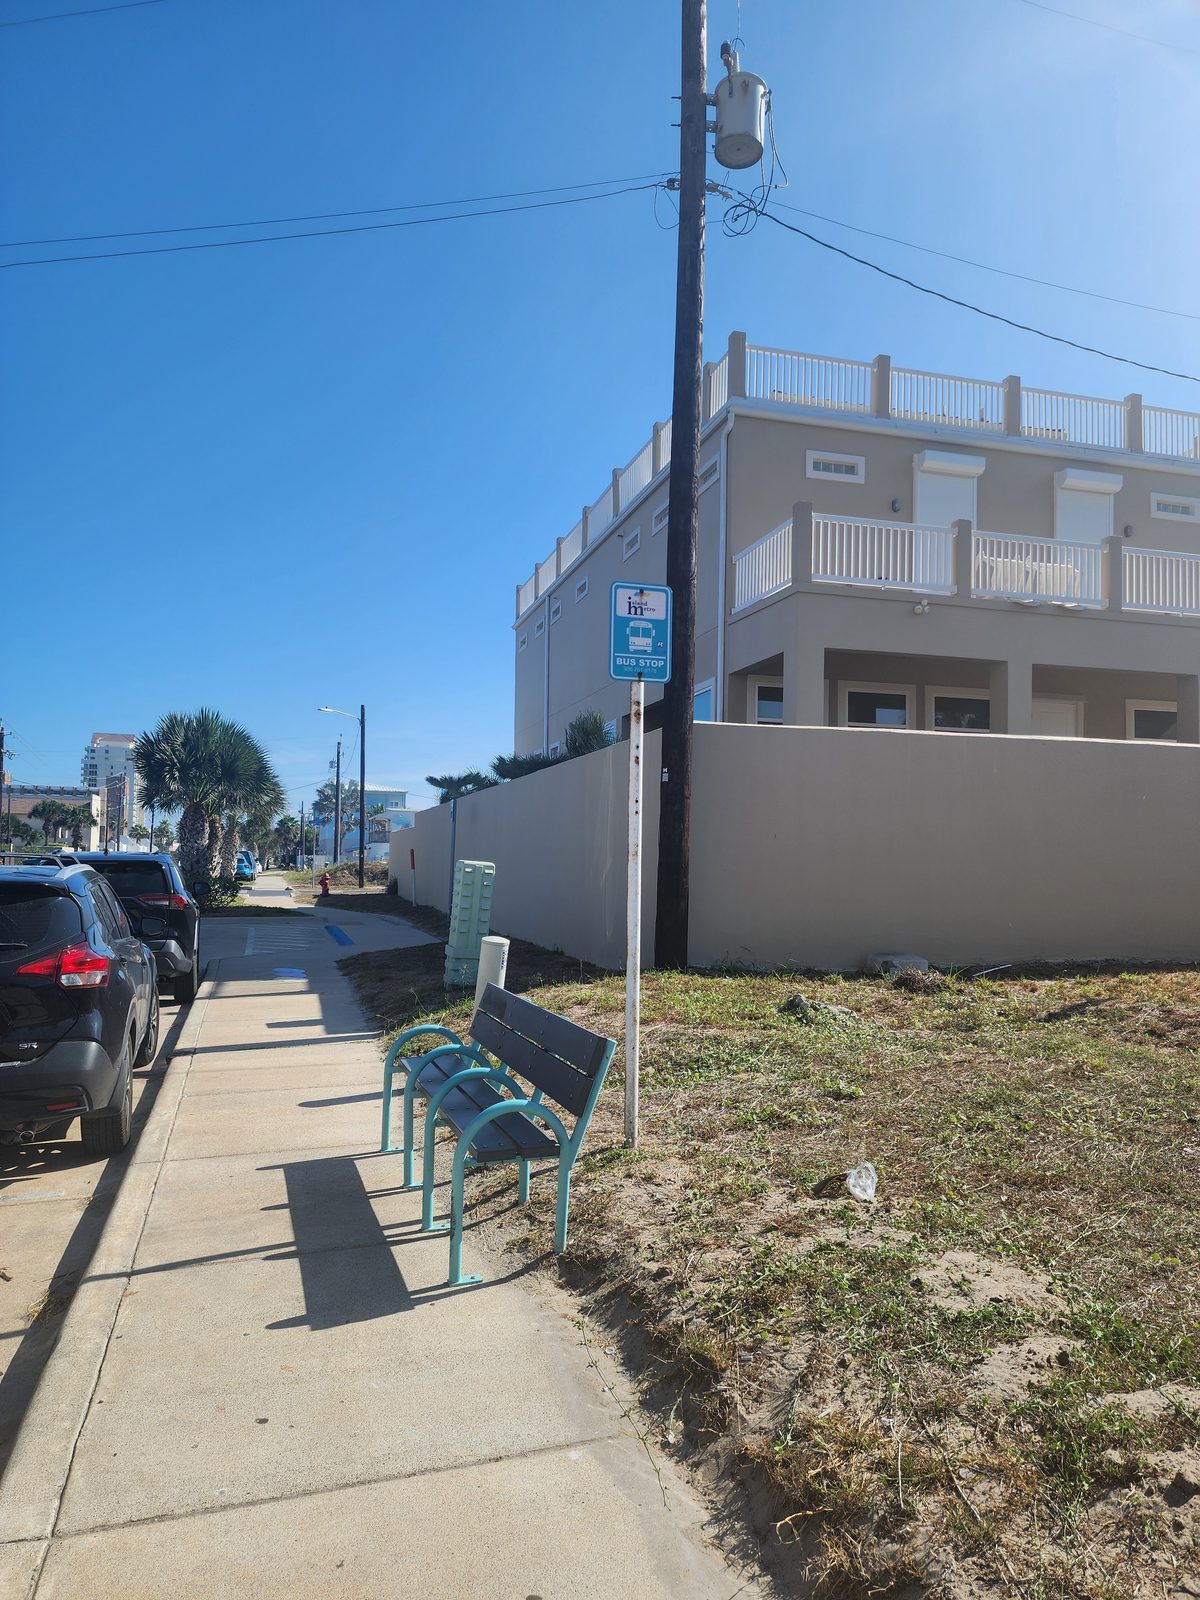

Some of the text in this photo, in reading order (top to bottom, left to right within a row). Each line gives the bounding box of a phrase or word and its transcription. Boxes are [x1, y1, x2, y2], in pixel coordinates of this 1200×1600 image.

[631, 605, 656, 616] metro
[616, 657, 665, 668] BUS STOP
[18, 1042, 38, 1050] SR
